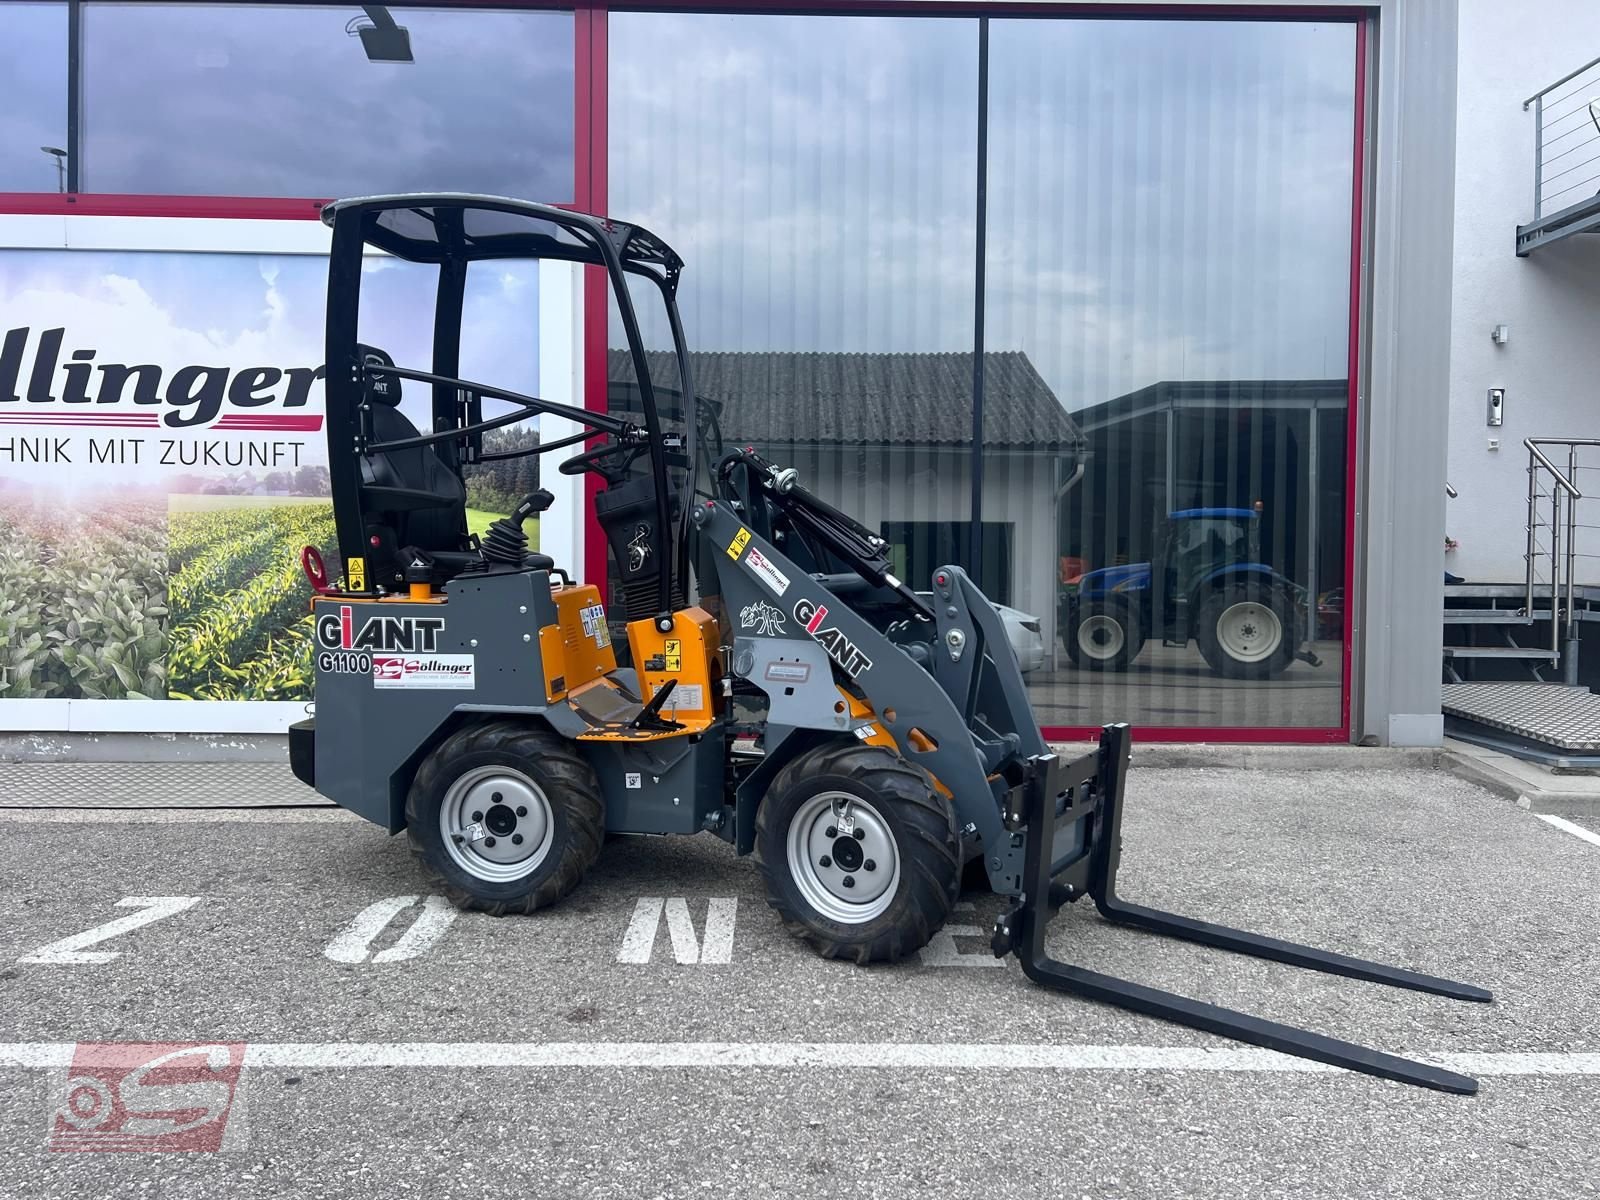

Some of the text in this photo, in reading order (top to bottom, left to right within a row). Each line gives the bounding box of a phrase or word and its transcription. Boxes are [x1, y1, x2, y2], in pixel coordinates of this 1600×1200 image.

[89, 439, 145, 464] MIT
[160, 440, 305, 467] ZUKUNFT
[319, 652, 371, 674] G1100
[404, 660, 472, 674] Söllinger
